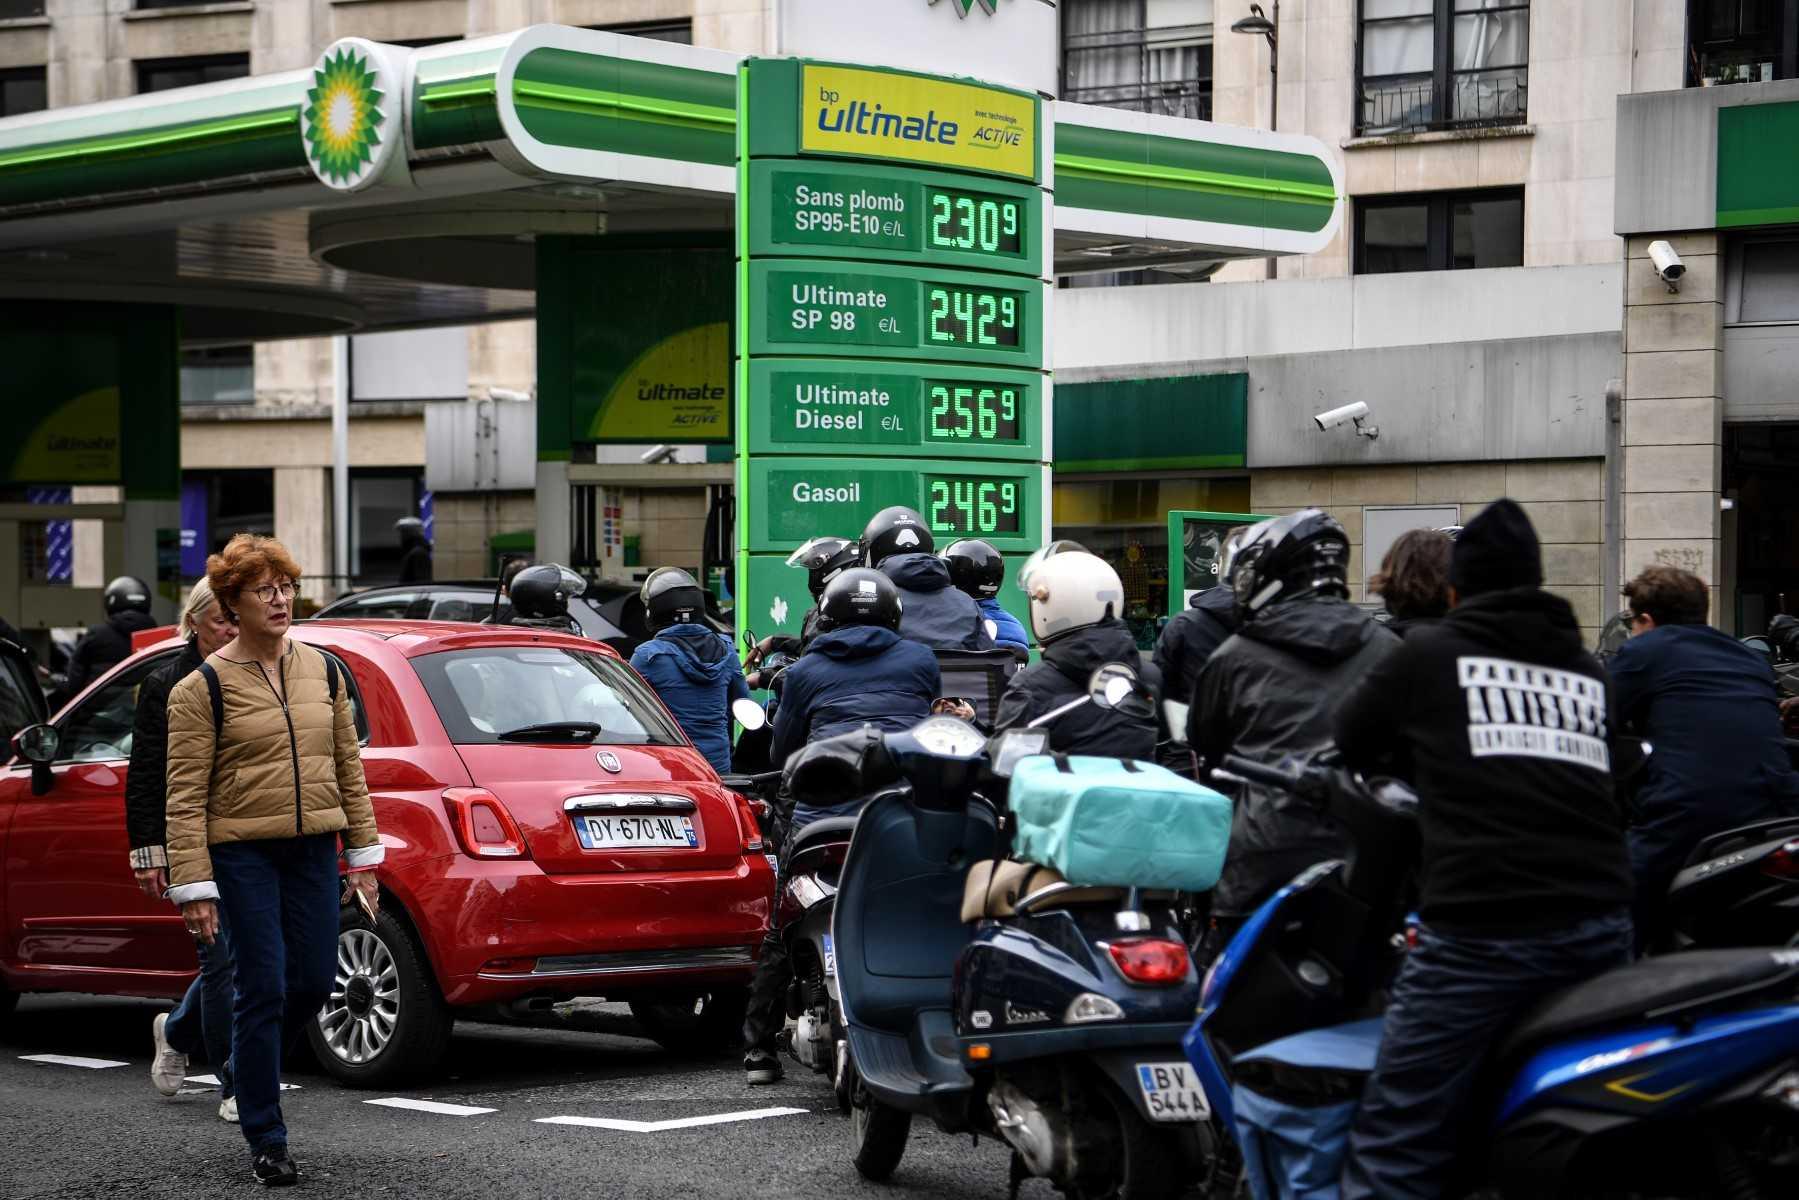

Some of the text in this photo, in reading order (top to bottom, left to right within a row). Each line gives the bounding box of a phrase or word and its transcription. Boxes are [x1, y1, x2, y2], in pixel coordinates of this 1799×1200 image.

[820, 86, 840, 105] bp
[818, 100, 959, 145] ultimate
[973, 126, 1023, 147] ACTIVE
[795, 185, 905, 213] Sans plomb
[795, 210, 905, 237] SP95-E10 €/L
[792, 284, 887, 308] Ultimate
[791, 309, 901, 334] SP 98 €/L
[637, 383, 725, 401] ultimate
[795, 384, 890, 407] Ultimate
[795, 409, 904, 431] Diesel €/L
[792, 482, 860, 503] Gasoil
[686, 831, 697, 842] 75
[1154, 1067, 1185, 1089] BV
